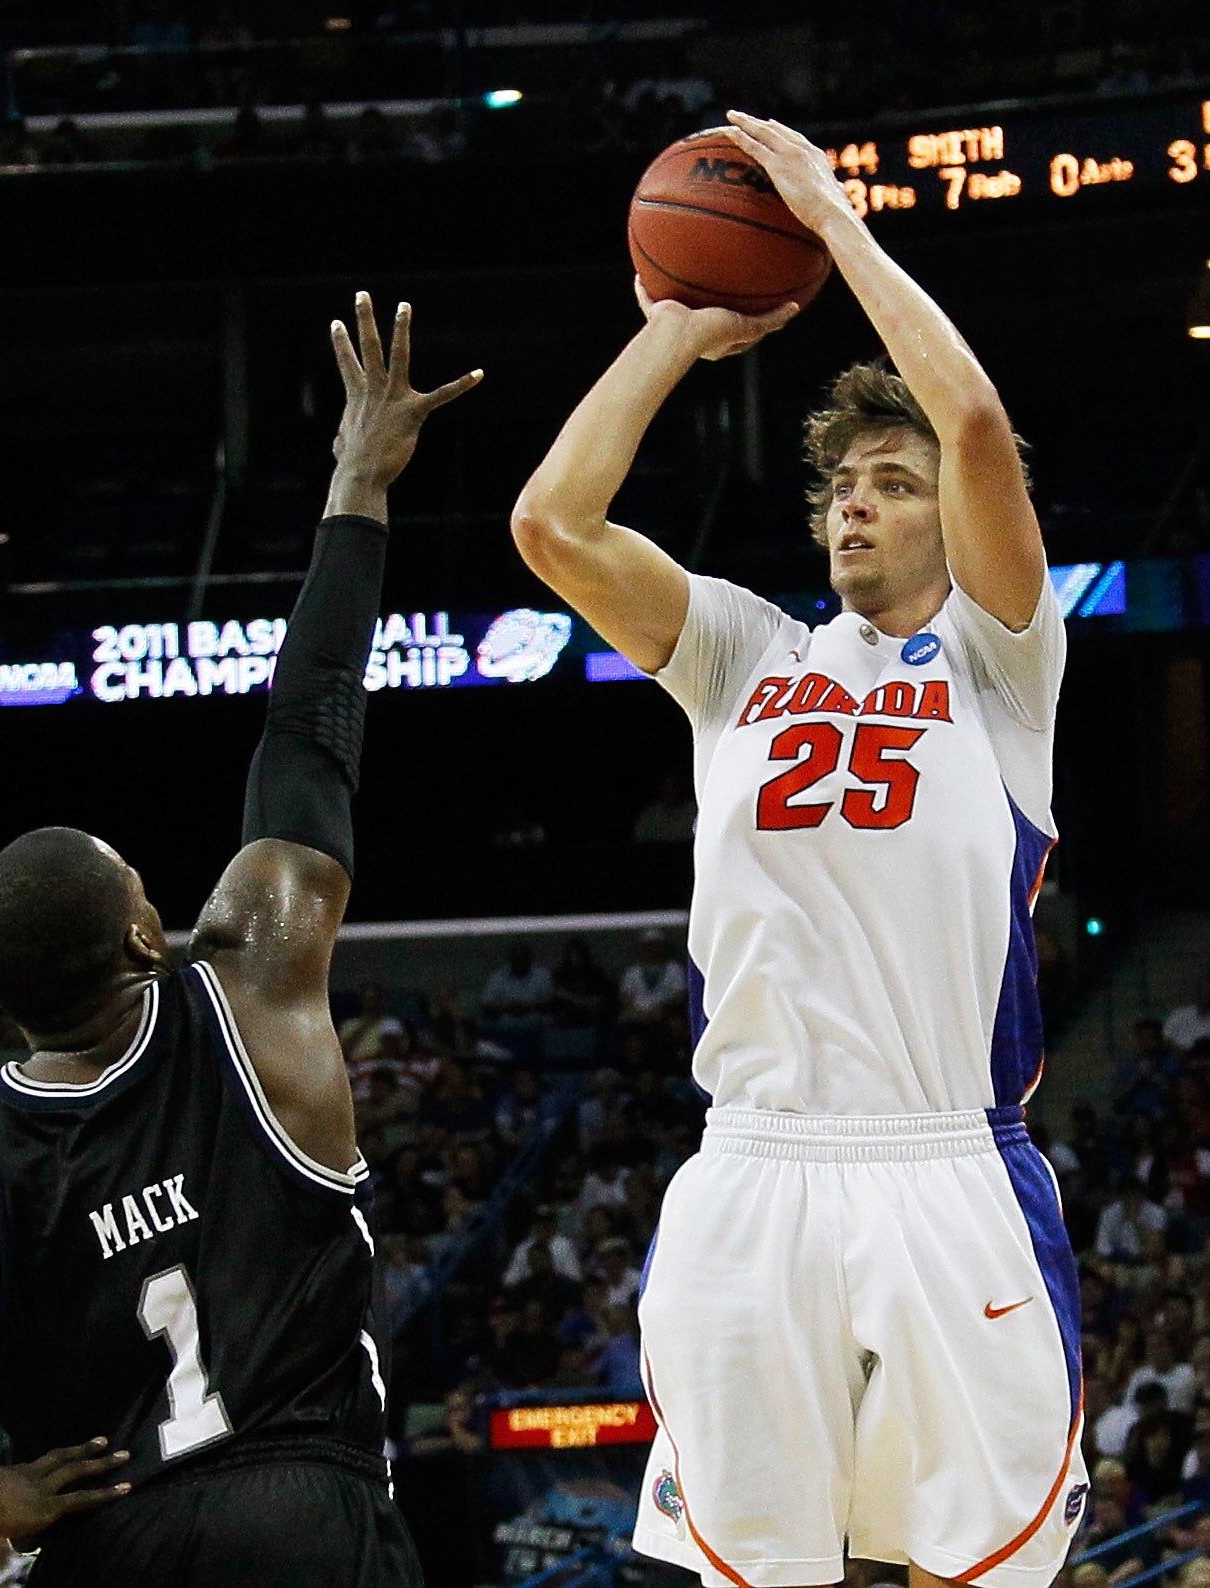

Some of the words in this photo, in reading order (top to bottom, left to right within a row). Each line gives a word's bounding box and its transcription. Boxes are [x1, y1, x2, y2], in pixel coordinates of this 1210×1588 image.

[908, 126, 1003, 169] SMITH
[92, 622, 179, 663] 2011
[187, 611, 465, 658] BASALL
[908, 641, 938, 663] NCAA
[91, 646, 470, 703] CHAMPSHIP
[756, 722, 928, 831] 25
[89, 1173, 199, 1260] MACK
[136, 1262, 235, 1462] 1
[508, 1403, 639, 1432] EMERGENCY
